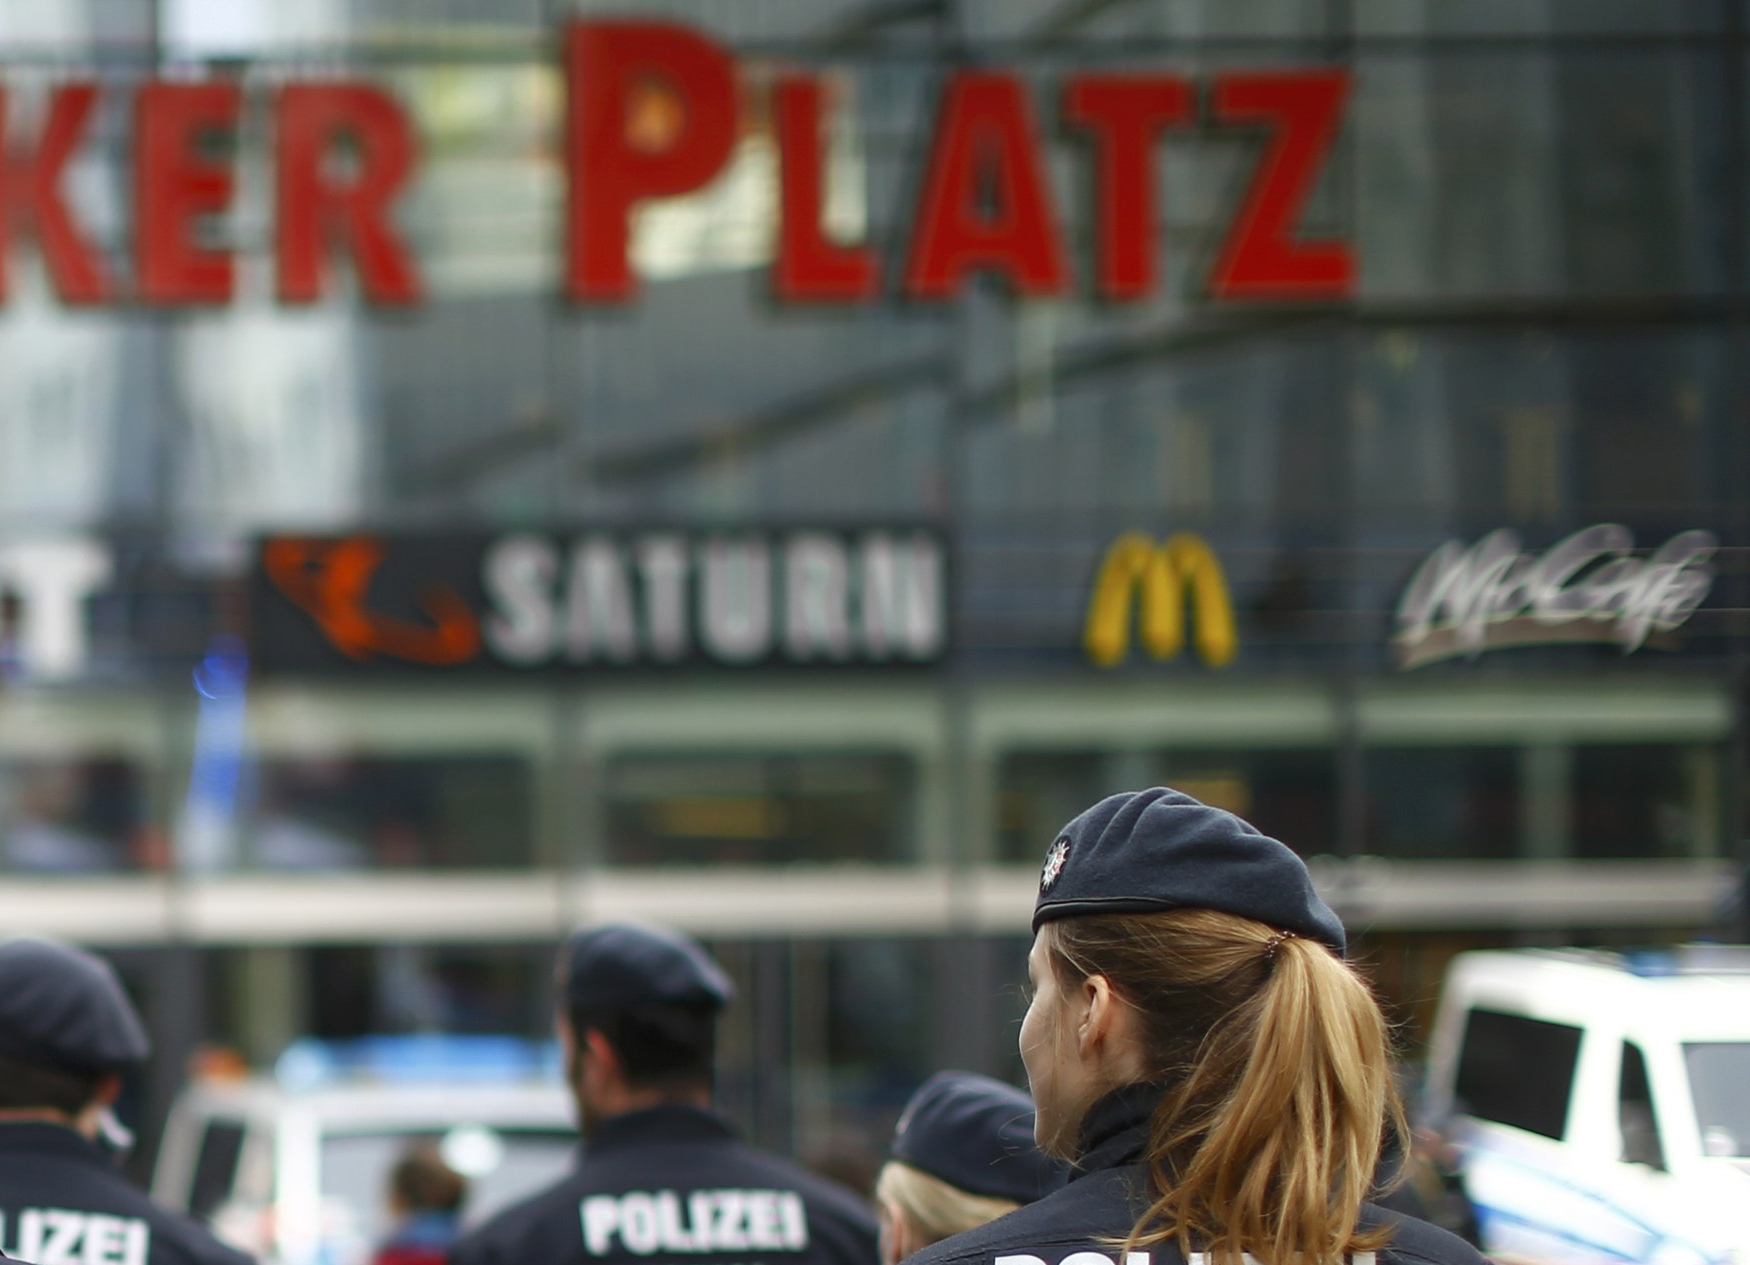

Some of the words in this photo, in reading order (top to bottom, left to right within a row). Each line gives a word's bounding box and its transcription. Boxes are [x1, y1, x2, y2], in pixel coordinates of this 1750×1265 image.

[568, 20, 1358, 303] PLATZ
[483, 532, 943, 665] SATURN
[580, 1188, 808, 1256] POLIZEI
